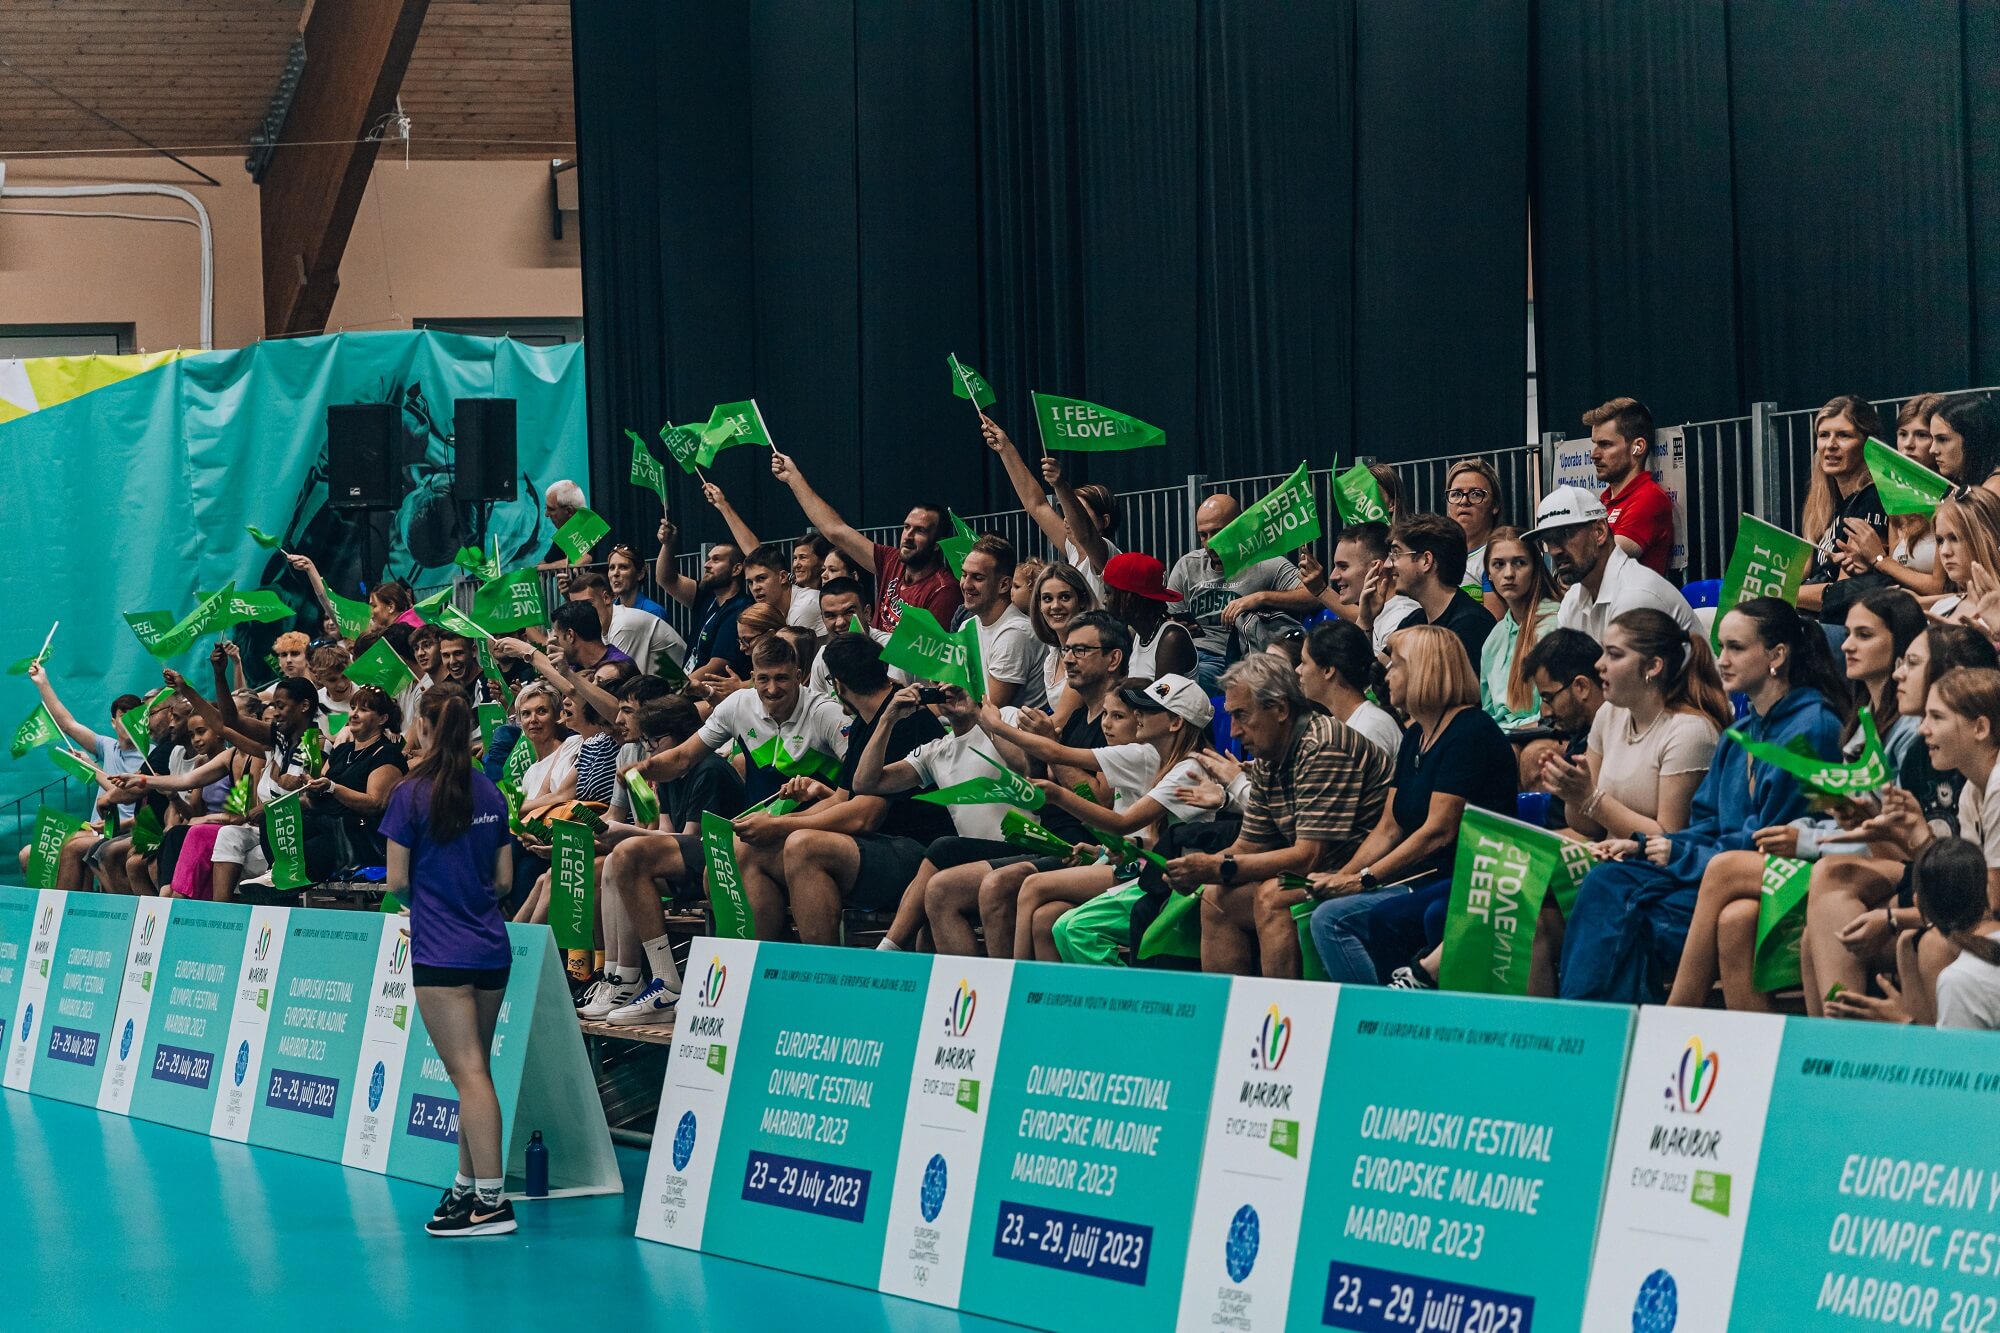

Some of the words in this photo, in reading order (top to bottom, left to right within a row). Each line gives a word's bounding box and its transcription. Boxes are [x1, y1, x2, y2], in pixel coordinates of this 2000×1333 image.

[1051, 406, 1060, 421] I
[1055, 419, 1135, 438] SLOVENI
[675, 438, 697, 463] LOVE
[175, 960, 206, 980] EUROPEAN
[205, 963, 226, 983] YOUTH
[169, 987, 195, 1007] OLYMPIC
[193, 989, 220, 1011] FESTIVAL
[323, 979, 354, 1003] FESTIVAL
[382, 981, 407, 999] MARIBOR
[1045, 993, 1083, 1008] EUROPEAN
[1084, 995, 1107, 1010] YOUTH
[1108, 997, 1140, 1013] OLYMPIC
[1140, 1000, 1174, 1017] FESTIVAL
[1175, 1002, 1197, 1018] 2023
[164, 1014, 191, 1035] MARIBOR
[190, 1018, 206, 1037] 2023
[284, 1006, 317, 1028] EVROPSKE
[315, 1011, 348, 1033] MLADINE
[690, 1015, 724, 1038] MARIBOR
[51, 1032, 60, 1050] 23
[62, 1034, 71, 1052] 29
[70, 1036, 81, 1059] July
[80, 1037, 96, 1057] 2023
[278, 1036, 309, 1058] MARIBOR
[307, 1040, 327, 1061] 2023
[775, 1030, 840, 1062] EUROPEAN
[840, 1038, 884, 1067] YOUTH
[1383, 1022, 1431, 1040] EUROPEAN
[1433, 1026, 1465, 1043] YOUTH
[1466, 1028, 1507, 1047] OLYMPIC
[1510, 1032, 1555, 1052] FESTIVAL
[1557, 1036, 1585, 1055] 2023
[156, 1051, 166, 1070] 23
[169, 1054, 180, 1073] 29
[178, 1056, 192, 1080] July
[191, 1058, 209, 1079] 2023
[420, 1057, 452, 1082] MARIB
[934, 1046, 976, 1072] MARIBOR
[1801, 1057, 1834, 1076] OFEM
[1839, 1061, 1910, 1084] OLIMPIJSKI
[1911, 1067, 1970, 1090] FESTIVAL
[270, 1076, 282, 1098] 23.
[288, 1079, 299, 1101] 29.
[297, 1081, 316, 1108] julij
[314, 1084, 335, 1107] 2023
[768, 1068, 820, 1100] OLYMPIC
[818, 1075, 873, 1108] FESTIVAL
[1026, 1064, 1105, 1102] OLIMPIJSKI
[1103, 1073, 1171, 1111] FESTIVAL
[1240, 1081, 1293, 1111] MARIBOR
[412, 1102, 425, 1126] 23.
[433, 1106, 447, 1130] 29.
[760, 1107, 816, 1140] MARIBOR
[815, 1115, 849, 1146] 2023
[1018, 1108, 1092, 1146] EVROPSKE
[1091, 1118, 1162, 1156] MLADINE
[1360, 1104, 1464, 1150] OLIMPIJSKI
[1463, 1116, 1553, 1162] FESTIVAL
[1649, 1124, 1722, 1161] MARIBOR
[749, 1161, 769, 1189] 23
[778, 1166, 798, 1195] 29
[797, 1170, 825, 1207] July
[824, 1174, 862, 1207] 2023
[1011, 1152, 1078, 1189] MARIBOR
[1077, 1161, 1118, 1196] 2023
[1351, 1154, 1449, 1200] EVROPSKE
[1449, 1168, 1544, 1215] MLADINE
[1838, 1154, 1984, 1210] EUROPEAN
[1001, 1212, 1025, 1247] 23.
[1040, 1219, 1064, 1254] 29.
[1063, 1223, 1101, 1268] julij
[1099, 1230, 1144, 1269] 2023
[1344, 1205, 1432, 1250] MARIBOR
[1431, 1218, 1485, 1261] 2023
[1828, 1213, 1942, 1267] OLYMPIC
[1332, 1274, 1363, 1315] 23.
[1384, 1284, 1416, 1326] 29.
[1415, 1289, 1465, 1333] julij
[1463, 1299, 1523, 1333] 2023
[1816, 1272, 1939, 1330] MARIBOR
[1940, 1290, 1999, 1333] 202
